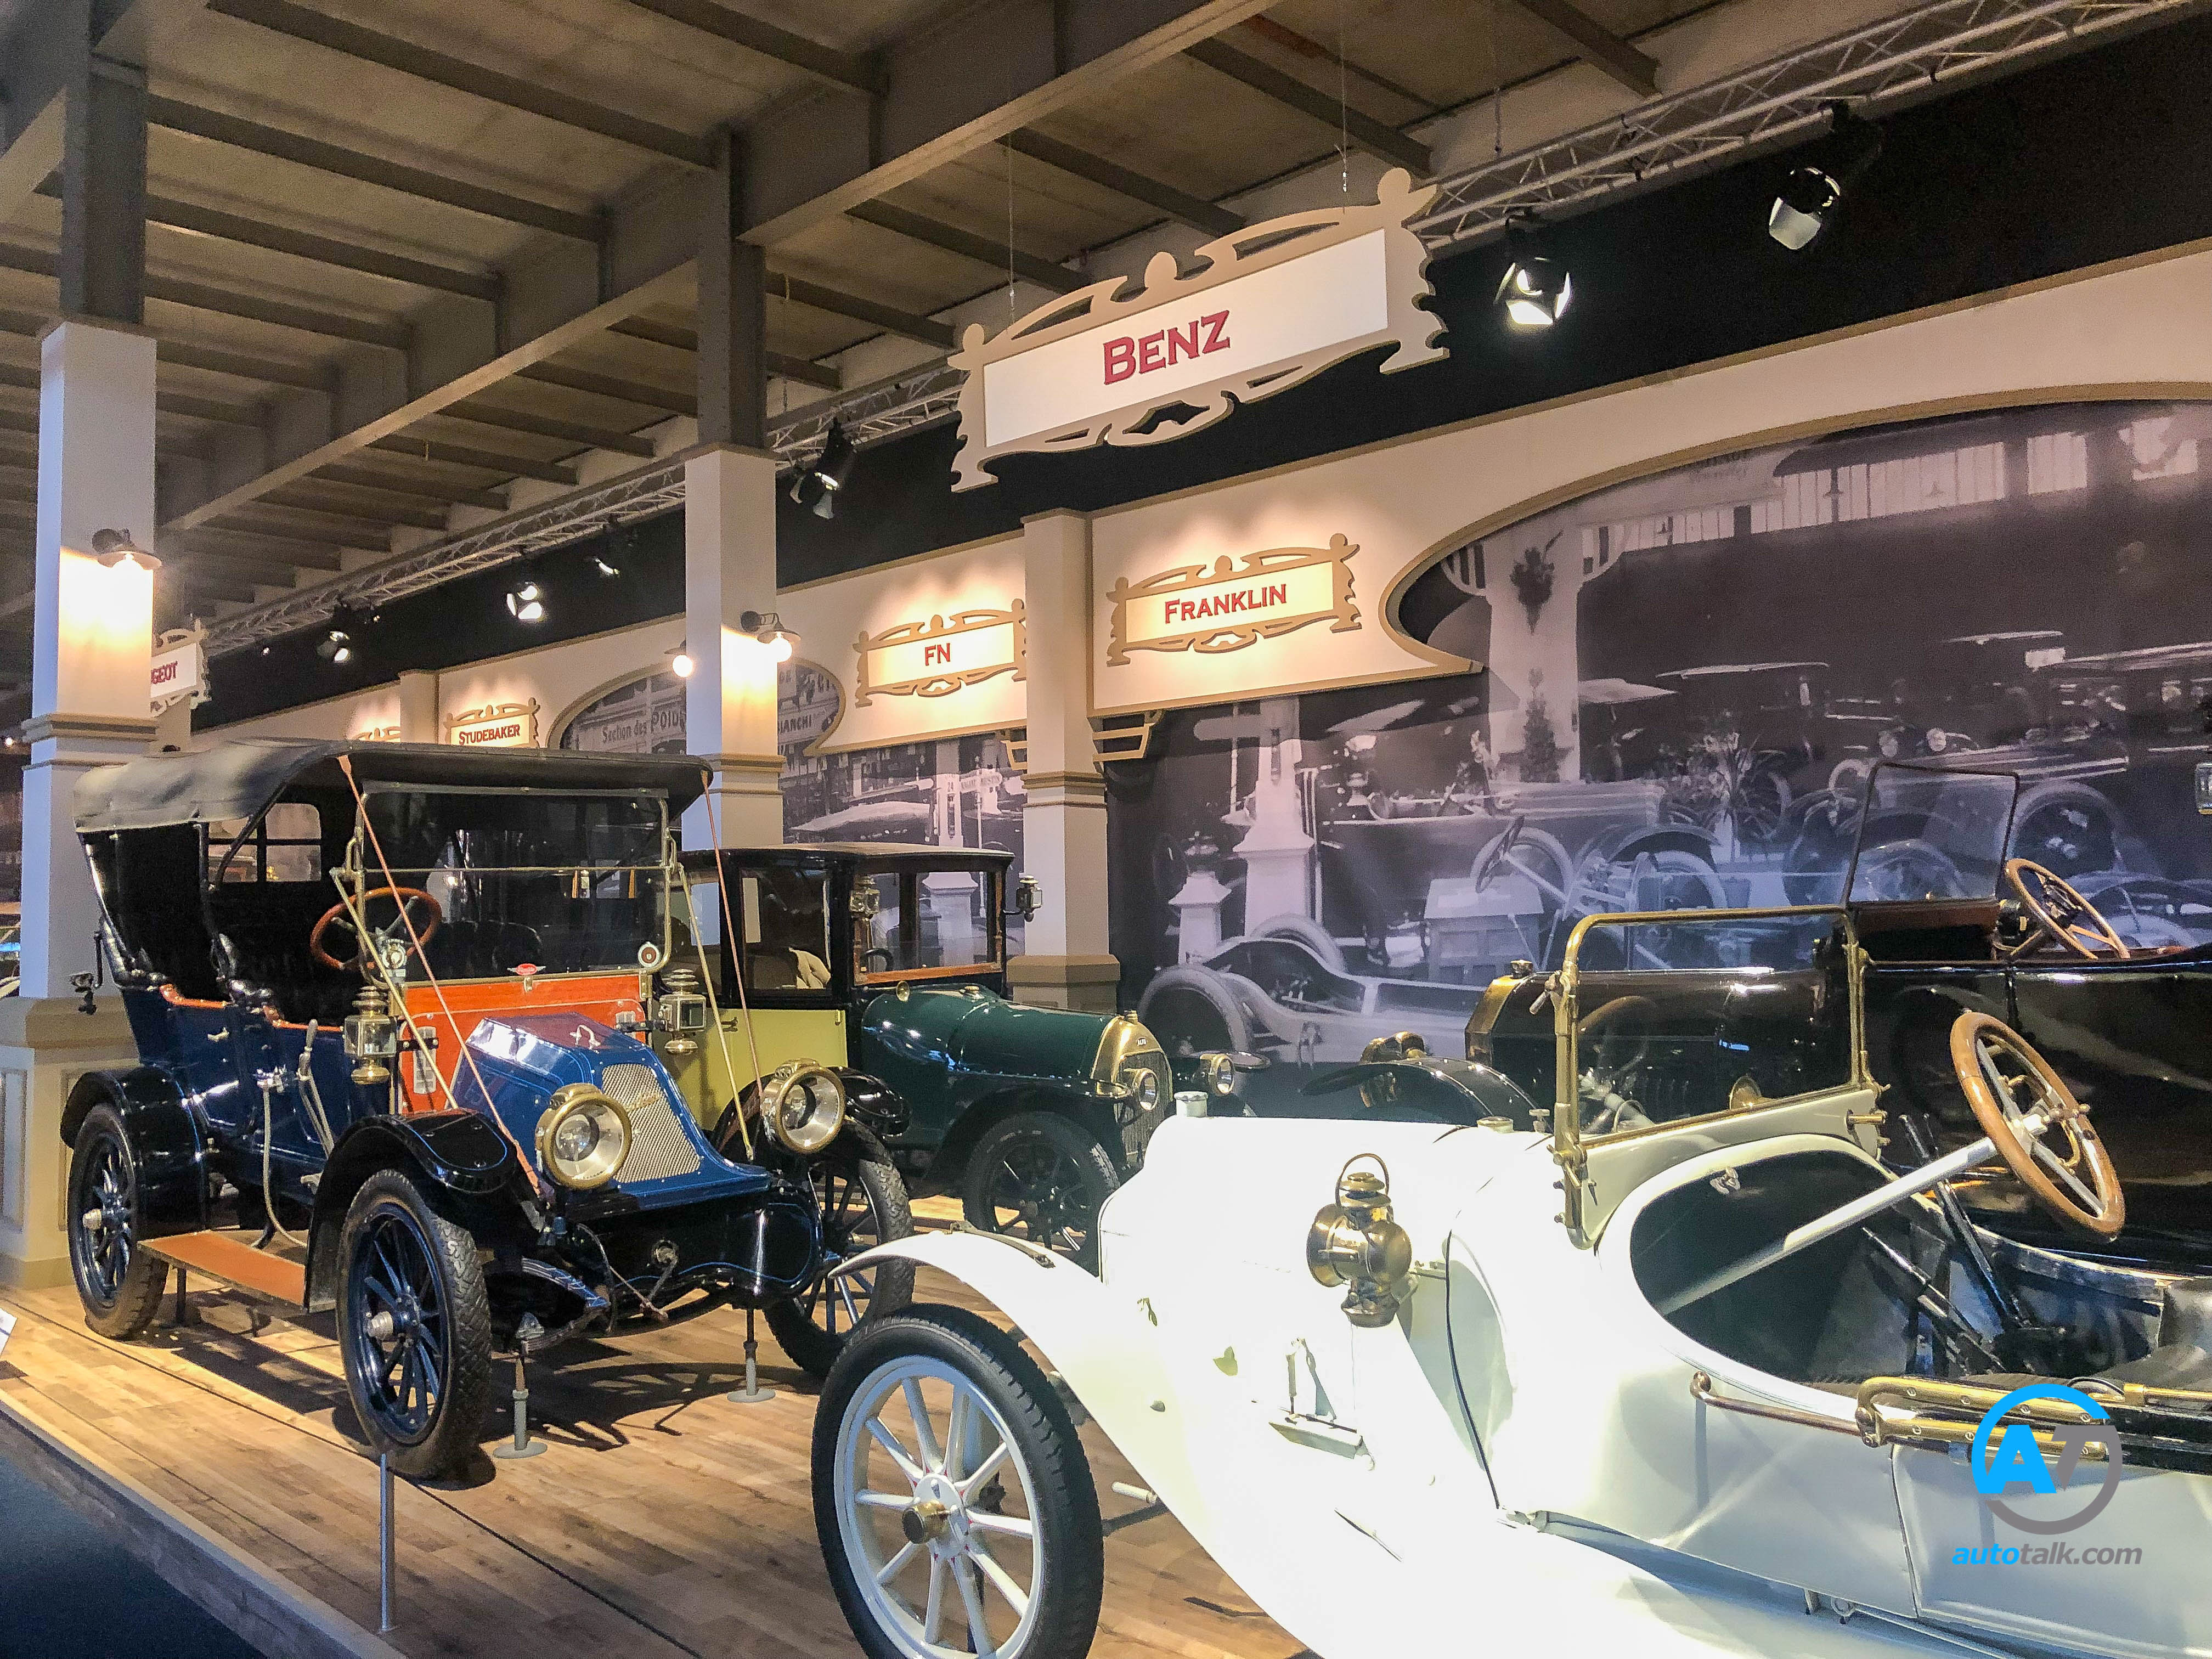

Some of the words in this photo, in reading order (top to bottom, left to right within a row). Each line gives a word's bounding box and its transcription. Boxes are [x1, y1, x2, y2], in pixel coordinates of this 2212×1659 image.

[1103, 310, 1231, 386] BENZ
[1164, 583, 1287, 624] FRANKLIN
[924, 642, 951, 666] FN
[151, 660, 178, 685] GEOT
[459, 724, 520, 746] STUDEBAKER
